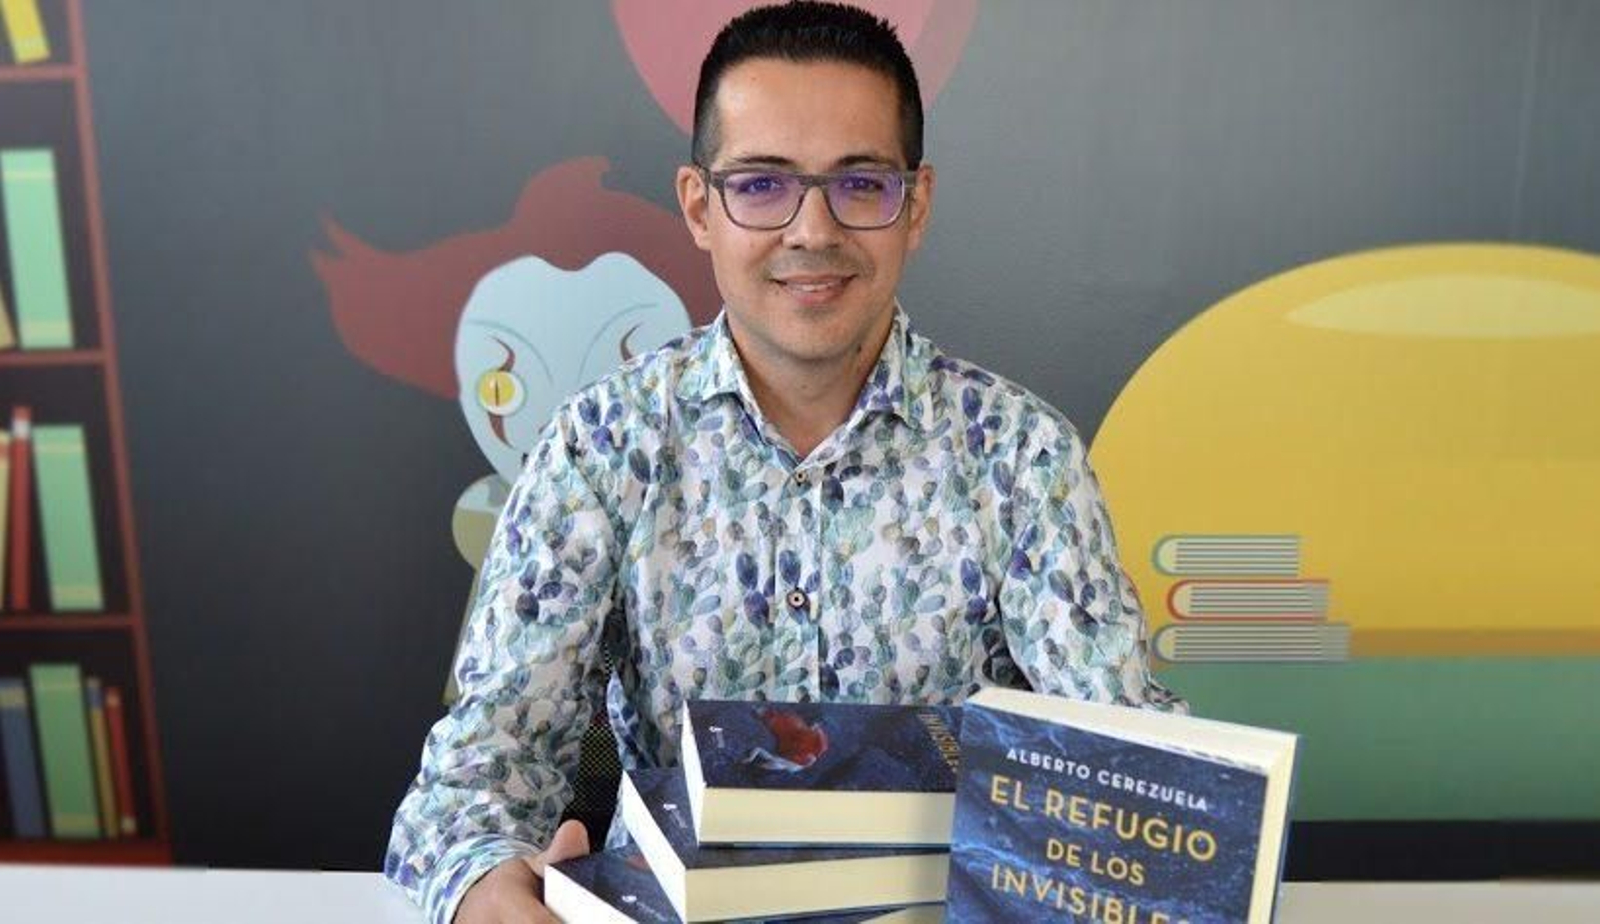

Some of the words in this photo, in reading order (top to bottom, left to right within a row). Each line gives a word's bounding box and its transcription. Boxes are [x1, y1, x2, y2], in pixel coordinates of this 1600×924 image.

[1006, 748, 1091, 780] ALBERTO
[1097, 770, 1208, 812] CEREZUELA
[990, 775, 1029, 811] EL
[1044, 788, 1217, 862] REFUGIO
[1046, 838, 1081, 868] DE
[1091, 852, 1145, 886] LOS
